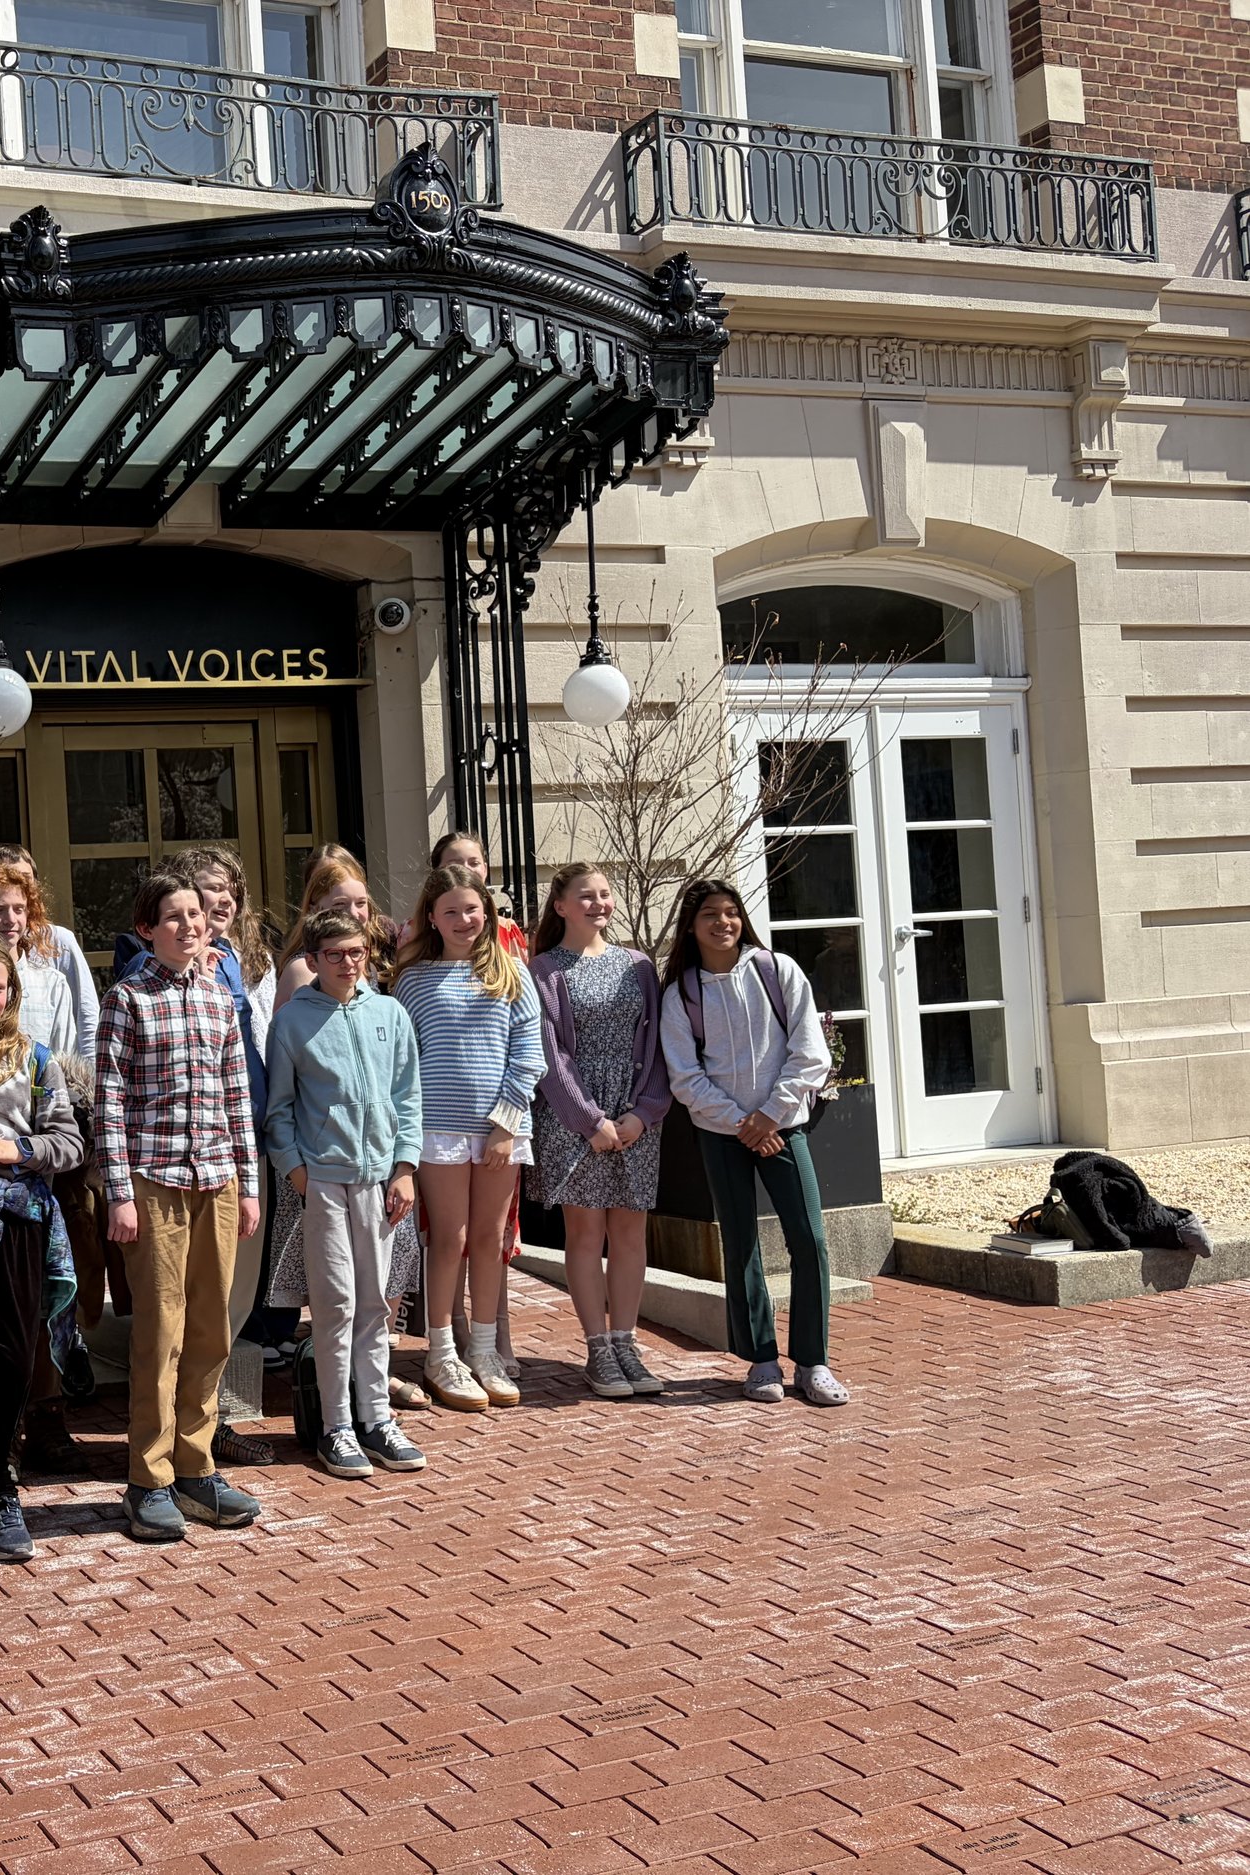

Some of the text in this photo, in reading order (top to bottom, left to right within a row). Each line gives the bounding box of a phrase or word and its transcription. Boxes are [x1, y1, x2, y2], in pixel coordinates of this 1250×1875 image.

[410, 191, 451, 215] 1509
[26, 648, 328, 683] VITAL VOICES
[386, 1752, 411, 1761] Ryan
[425, 1742, 457, 1752] Allison
[406, 1749, 452, 1763] Anderson
